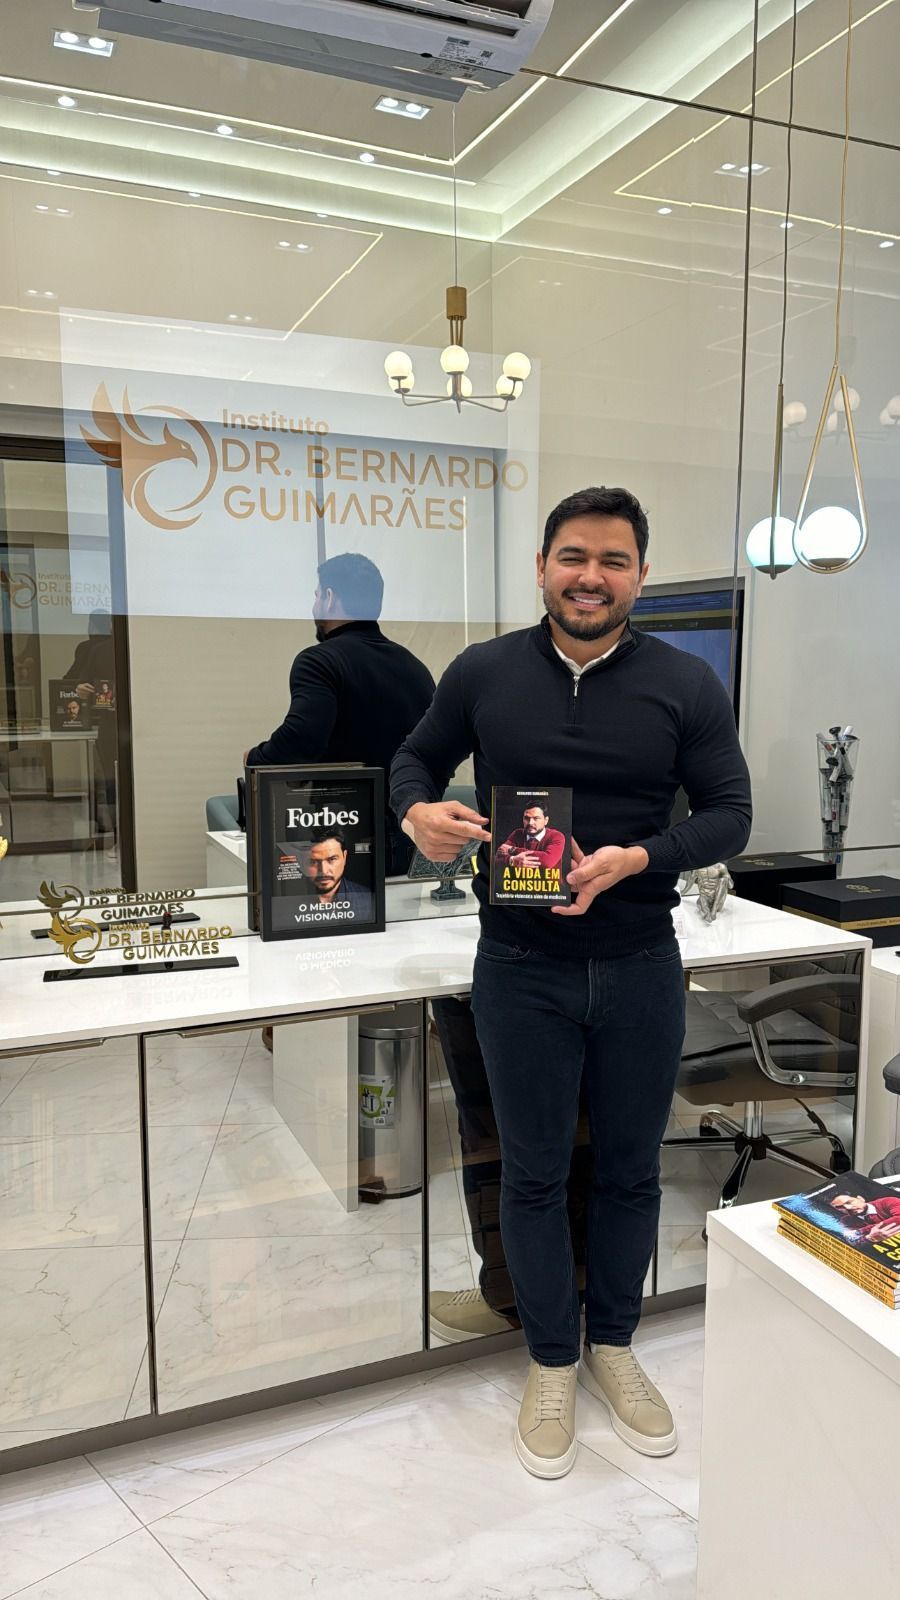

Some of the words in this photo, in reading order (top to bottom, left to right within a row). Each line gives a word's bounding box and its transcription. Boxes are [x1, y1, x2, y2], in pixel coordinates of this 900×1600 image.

[222, 408, 329, 437] Instituto
[221, 438, 292, 477] DR.
[307, 444, 528, 492] BERNARDO
[223, 485, 468, 531] GUIMARÃES
[286, 806, 359, 829] Forbes
[503, 867, 511, 879] A
[514, 867, 541, 879] VIDA
[545, 868, 560, 880] EM
[503, 879, 561, 892] CONSULTA
[116, 888, 196, 904] BERNARDO
[294, 910, 355, 923] VISIONÁRIO
[298, 903, 308, 912] O
[109, 933, 135, 948] DR.
[141, 925, 233, 945] BERNARDO
[123, 940, 220, 961] GUIMARÃES
[872, 1243, 889, 1254] A
